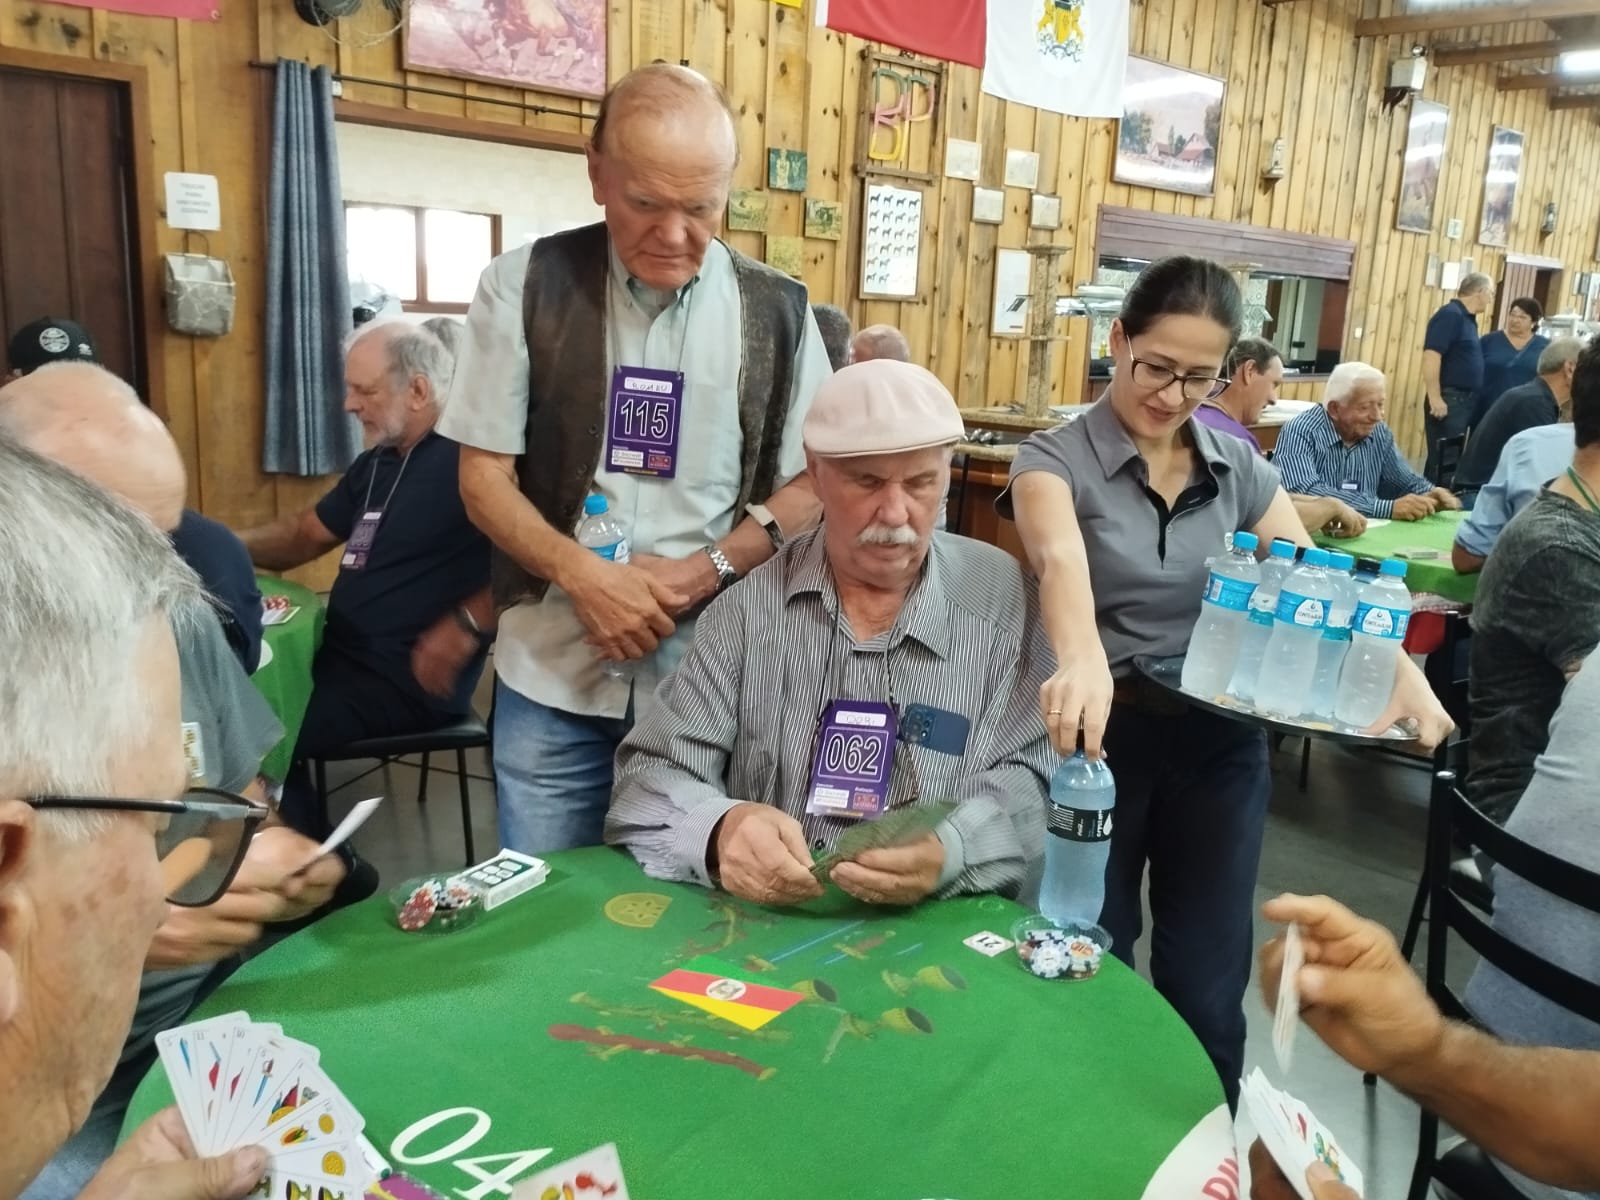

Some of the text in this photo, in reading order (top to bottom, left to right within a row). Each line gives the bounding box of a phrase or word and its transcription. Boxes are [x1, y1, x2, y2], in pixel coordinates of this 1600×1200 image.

[621, 399, 669, 439] 115
[825, 733, 882, 775] 062
[390, 1107, 553, 1200] 04
